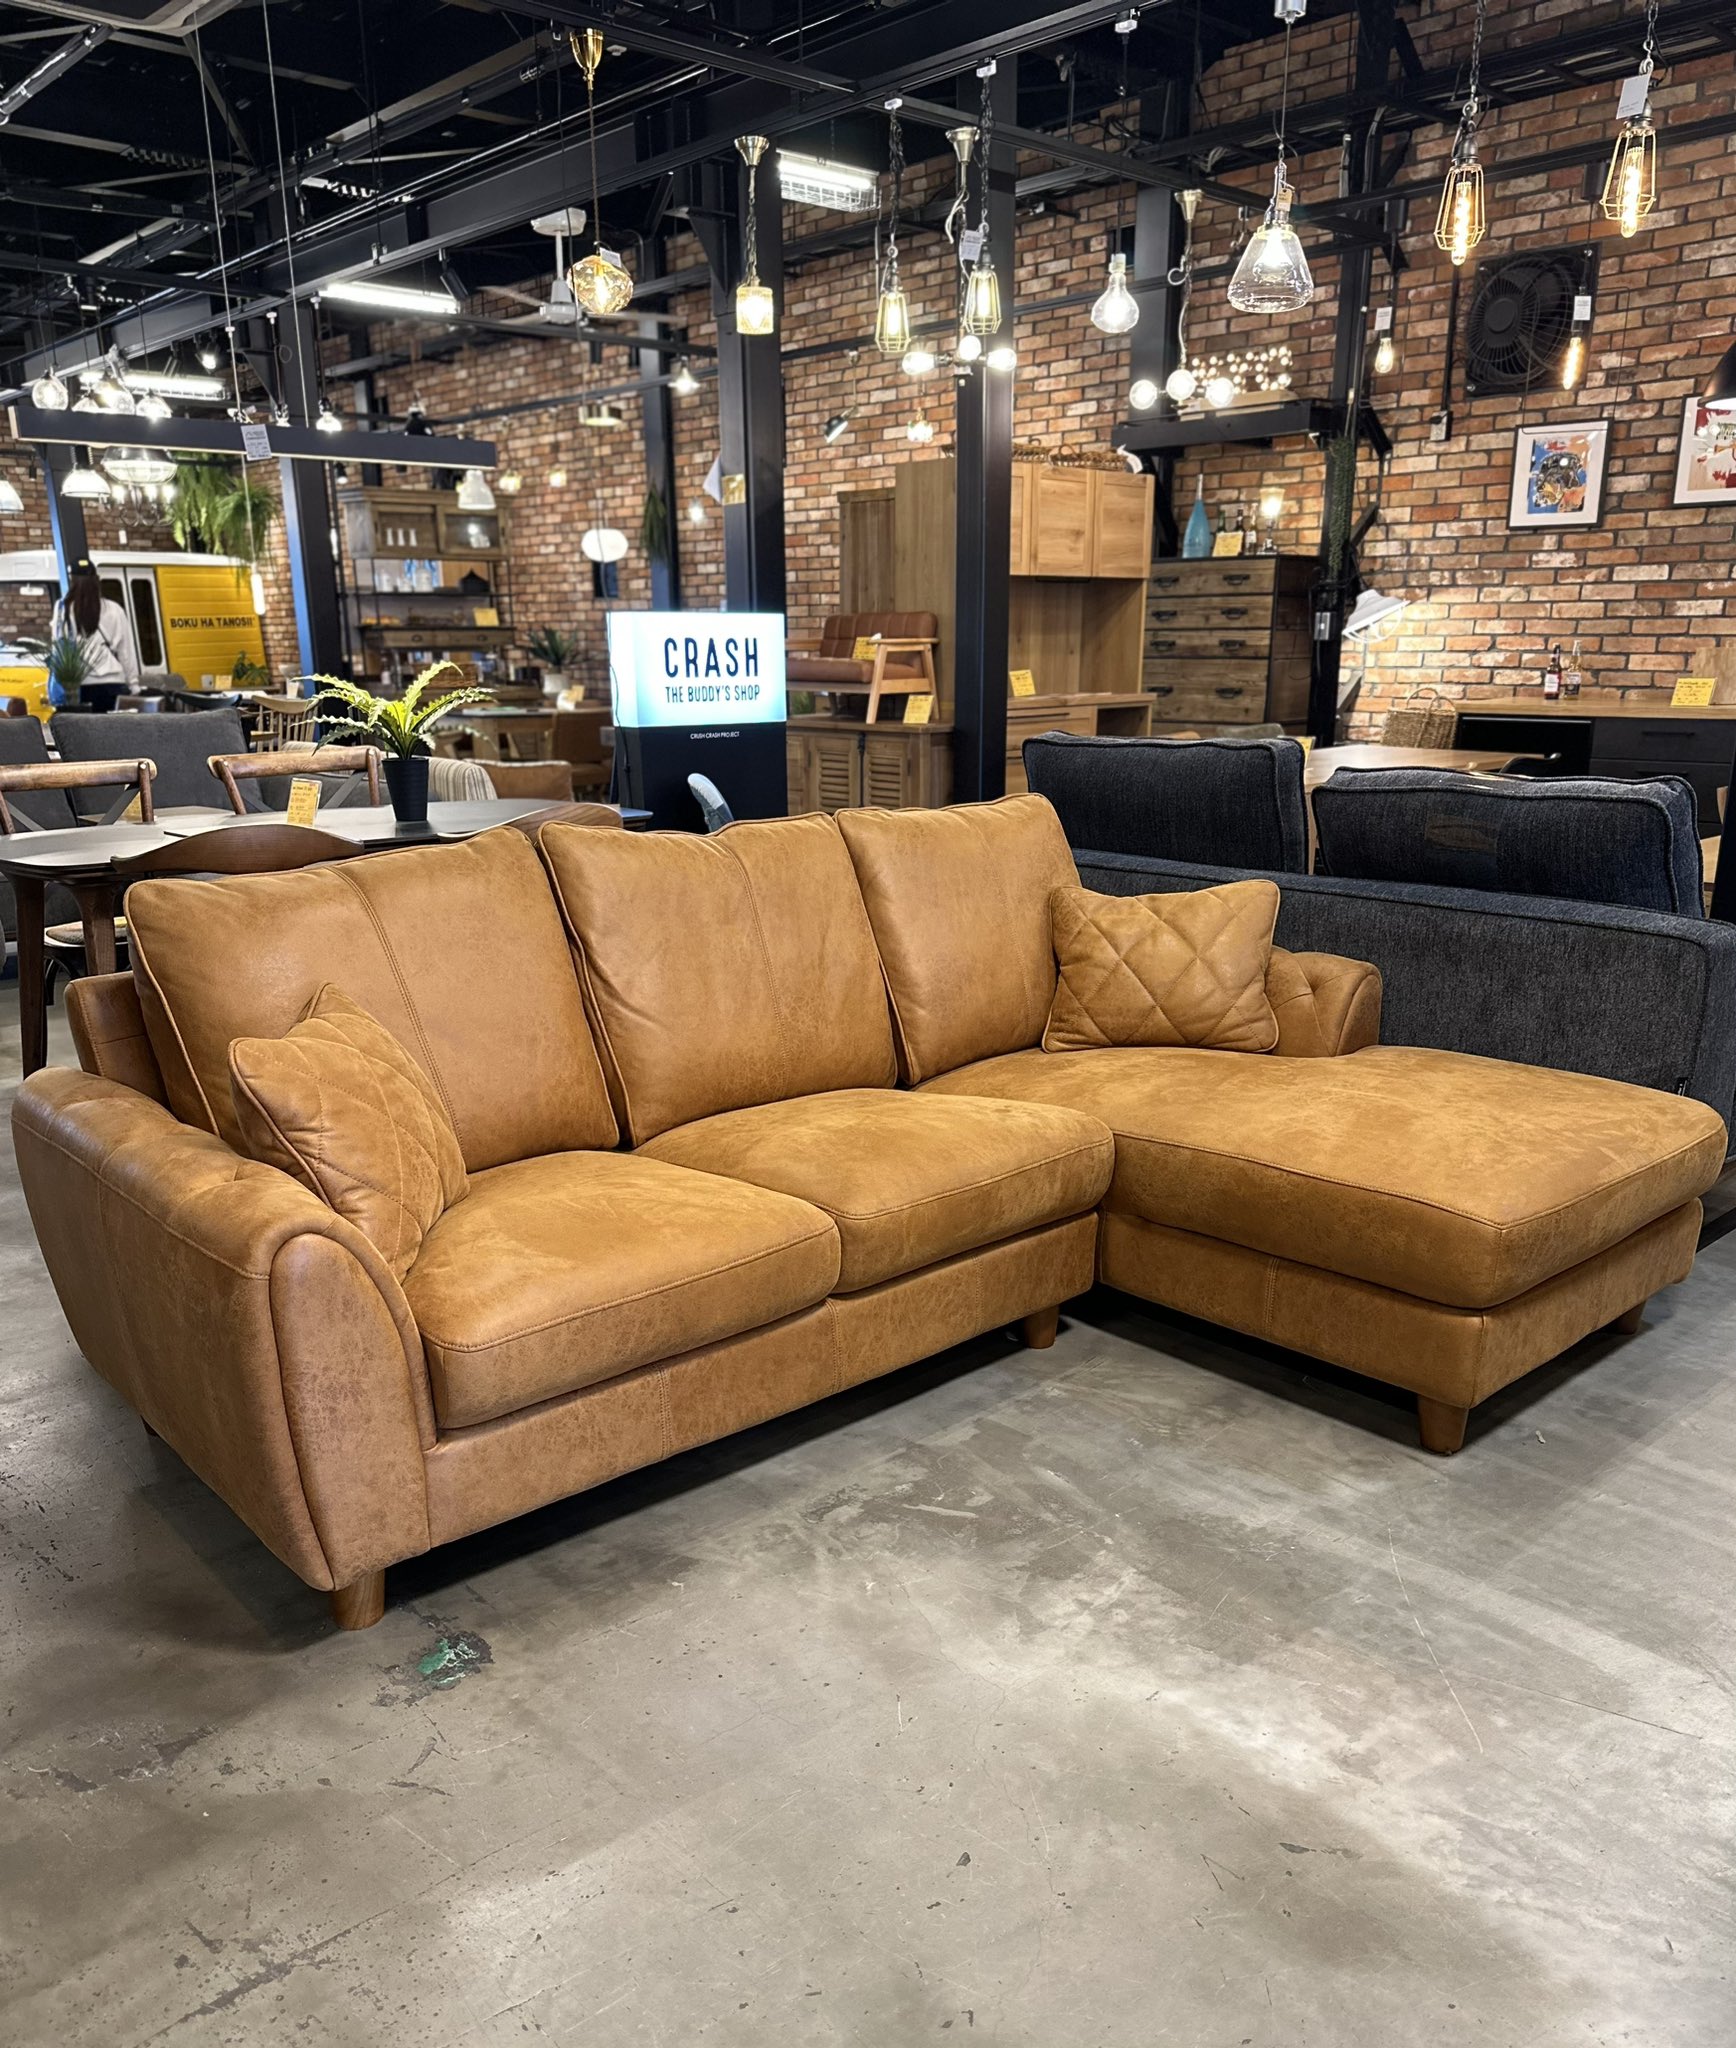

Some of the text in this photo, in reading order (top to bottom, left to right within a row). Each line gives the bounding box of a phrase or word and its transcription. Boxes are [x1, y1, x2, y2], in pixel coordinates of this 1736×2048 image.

[170, 618, 198, 628] BOKU
[201, 617, 215, 627] HA
[664, 637, 758, 678] CRASH
[665, 684, 760, 703] THE BUDDY'S SHOP
